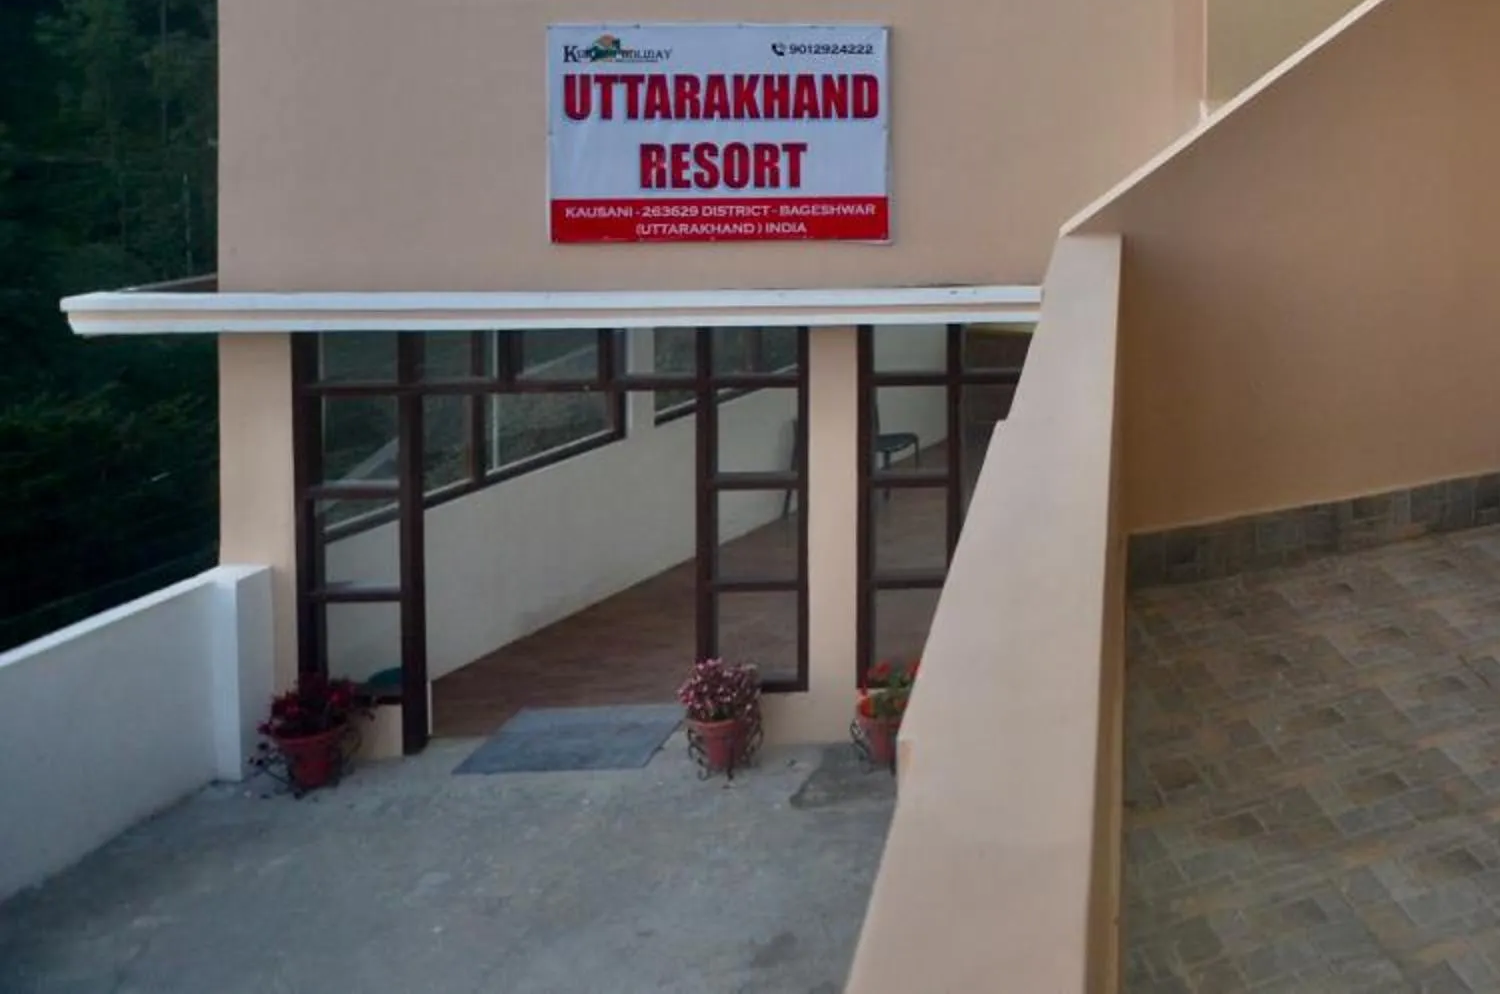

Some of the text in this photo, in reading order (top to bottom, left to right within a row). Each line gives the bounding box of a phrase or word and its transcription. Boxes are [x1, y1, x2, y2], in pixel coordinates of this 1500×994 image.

[564, 73, 879, 121] UTTARAKHAND
[639, 142, 808, 190] RESORT
[565, 206, 633, 218] KAUSANI
[779, 203, 876, 216] BAGESHWAR
[765, 222, 807, 233] INDIA
